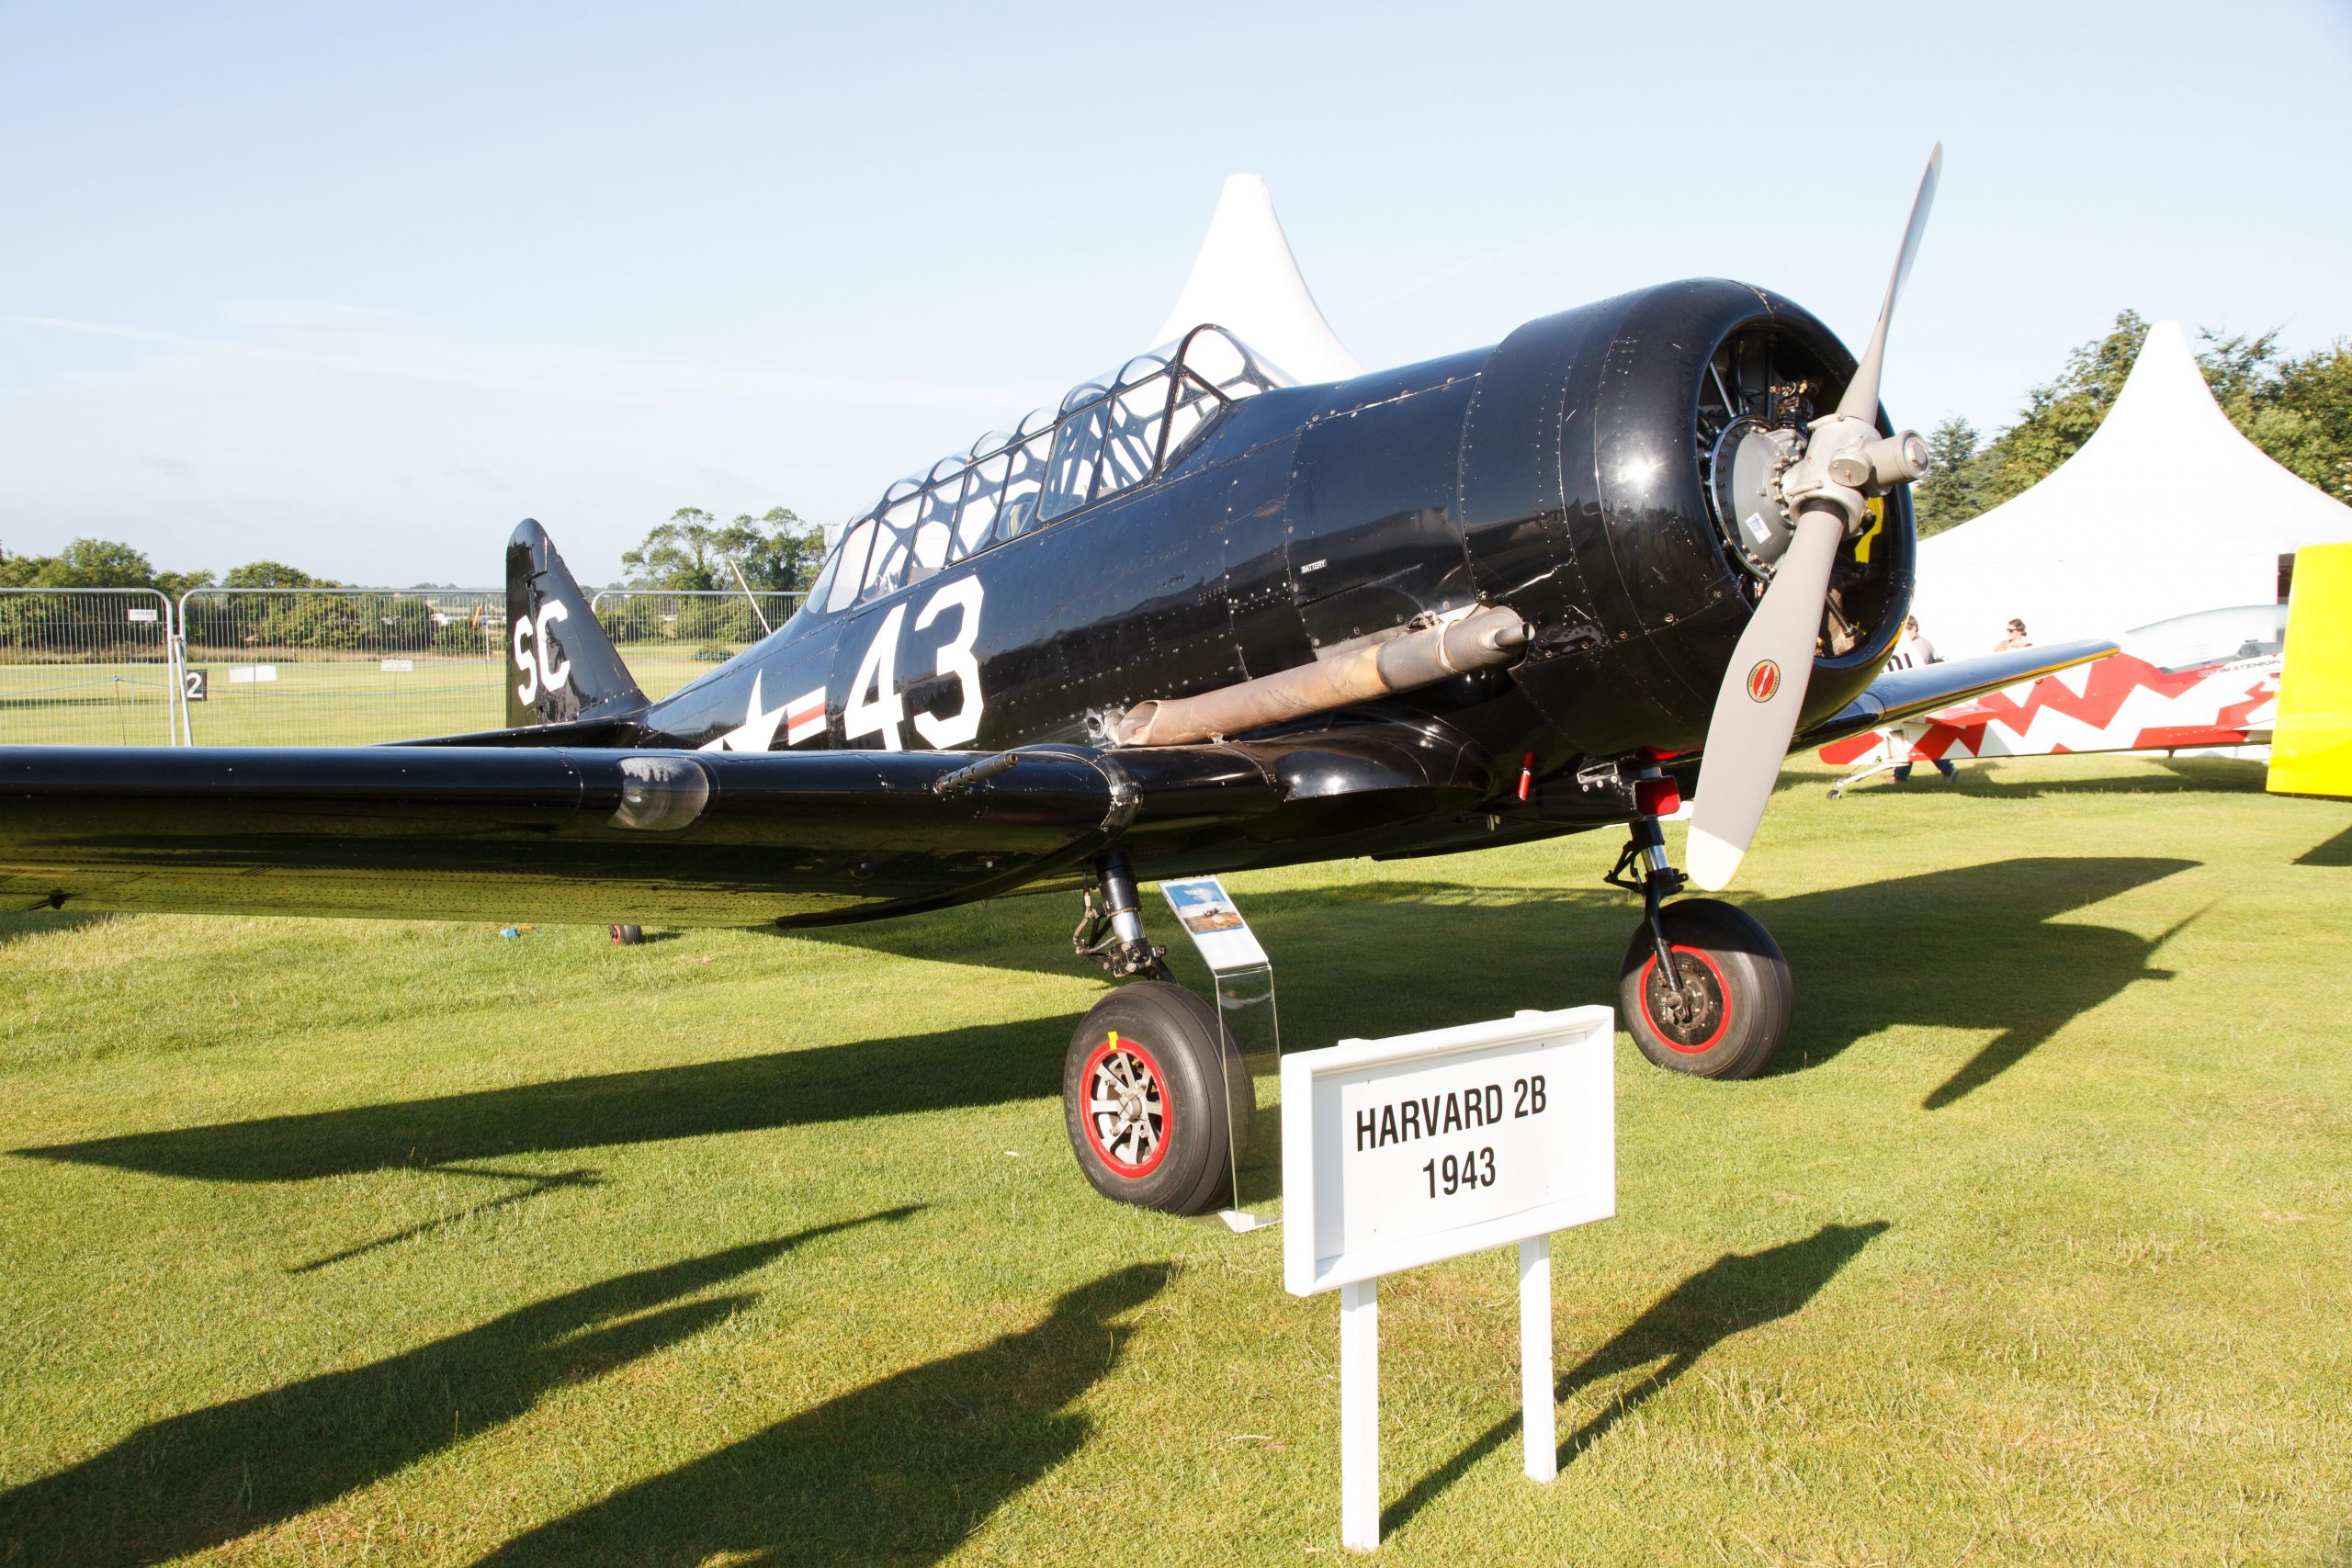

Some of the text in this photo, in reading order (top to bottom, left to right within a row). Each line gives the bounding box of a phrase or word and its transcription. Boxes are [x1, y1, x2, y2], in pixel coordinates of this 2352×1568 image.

[1301, 558, 1328, 574] BATTERY
[187, 672, 203, 697] 2
[514, 598, 571, 706] SC
[843, 574, 985, 751] 43
[1356, 1075, 1546, 1152] HARVARD 2B
[1422, 1146, 1496, 1199] 1943
